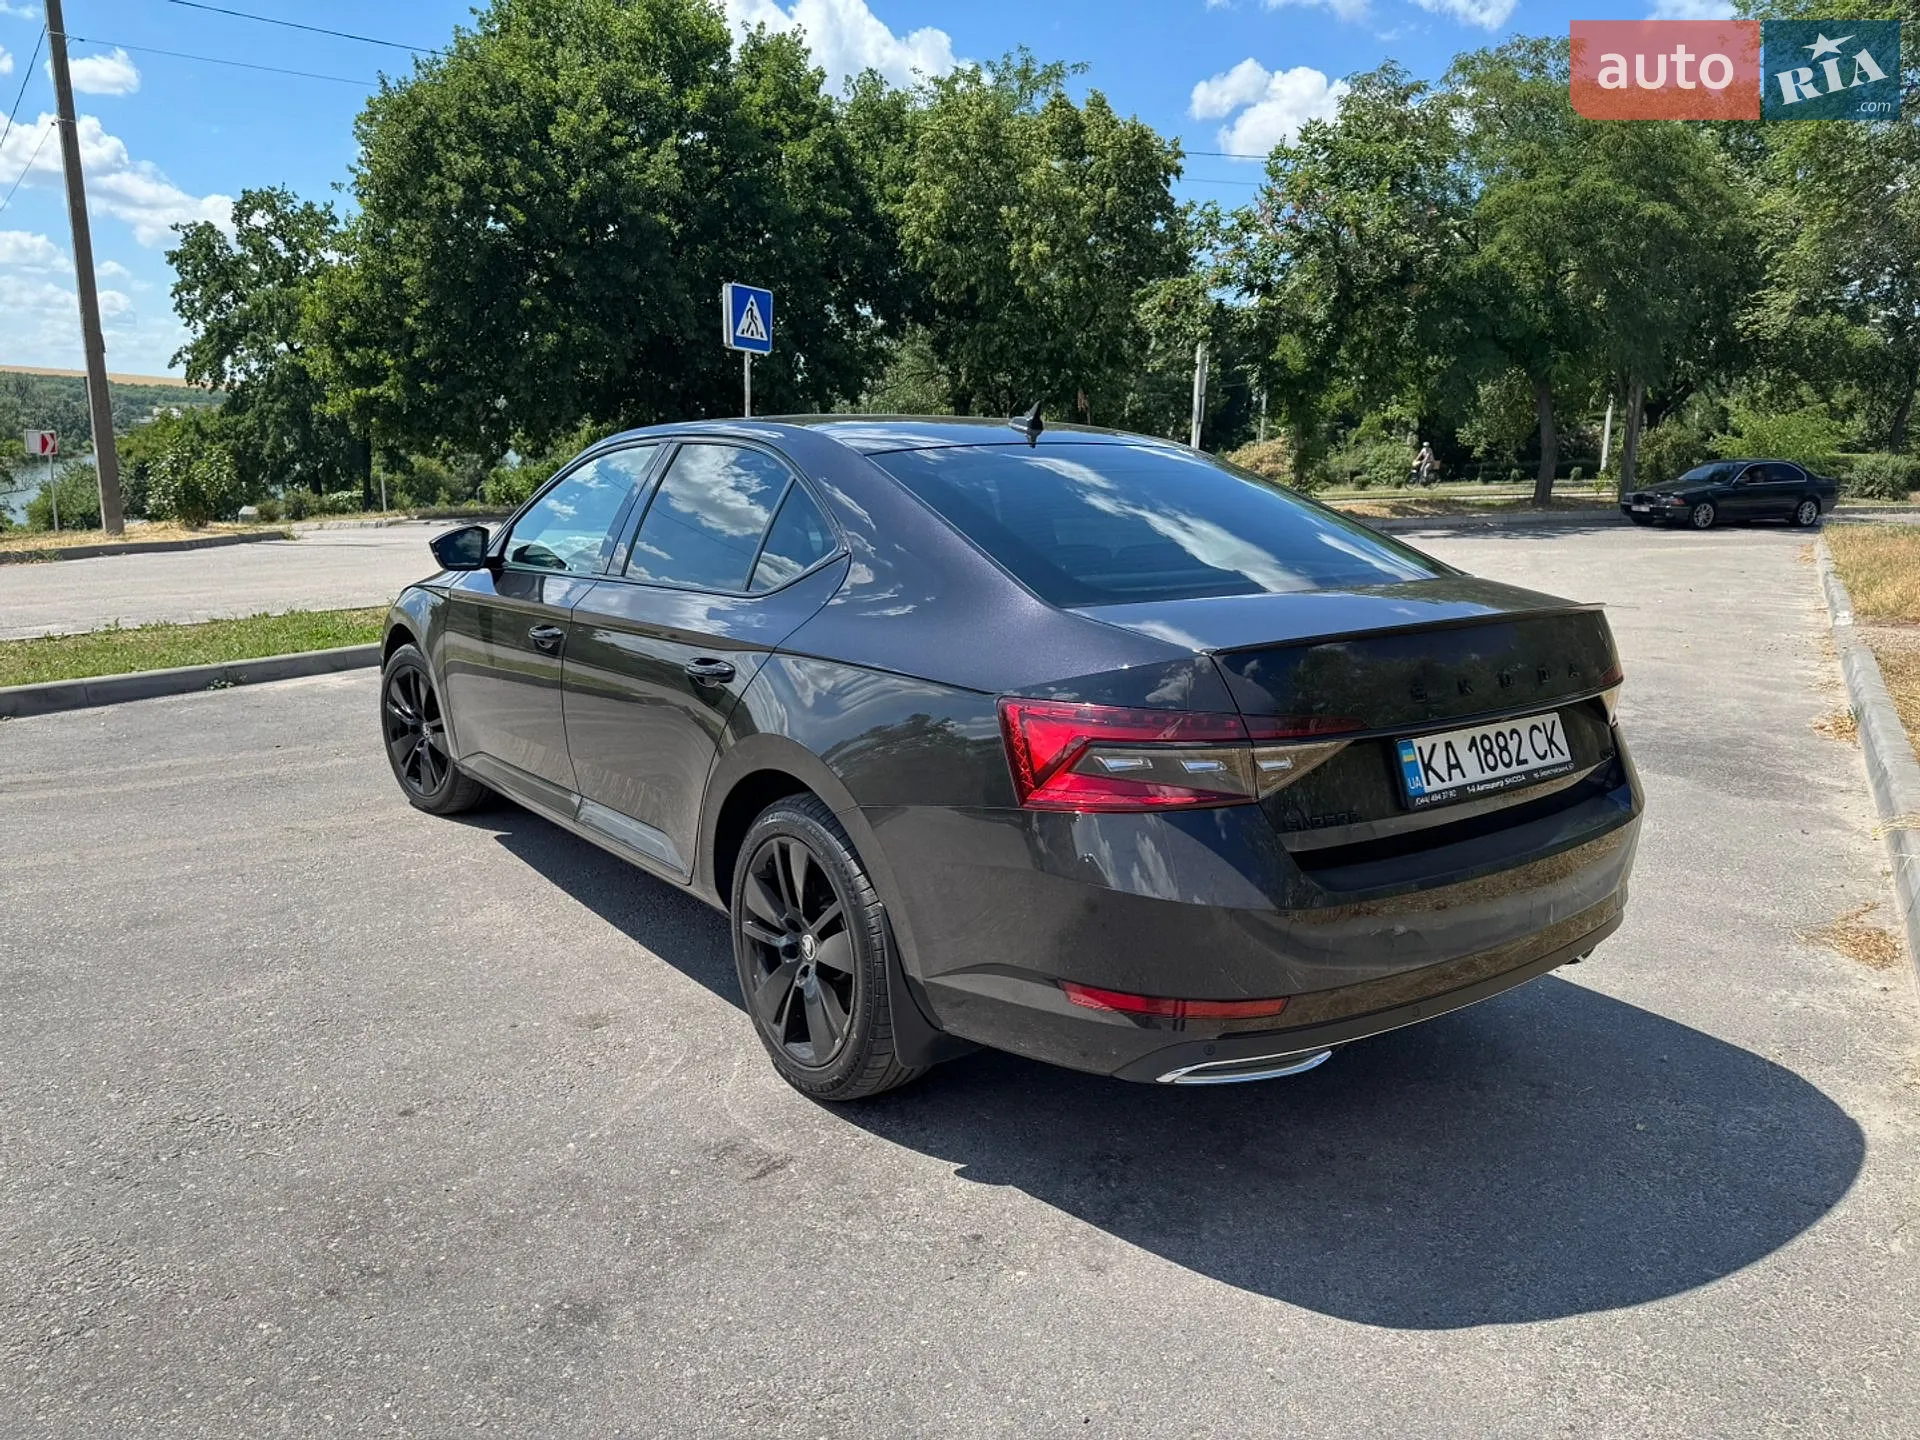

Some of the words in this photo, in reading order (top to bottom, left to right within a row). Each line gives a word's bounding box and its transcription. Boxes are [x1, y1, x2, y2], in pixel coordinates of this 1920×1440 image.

[1417, 740, 1467, 786] KA
[1467, 727, 1529, 774] 1882
[1529, 719, 1566, 761] CK
[1408, 776, 1423, 790] UA
